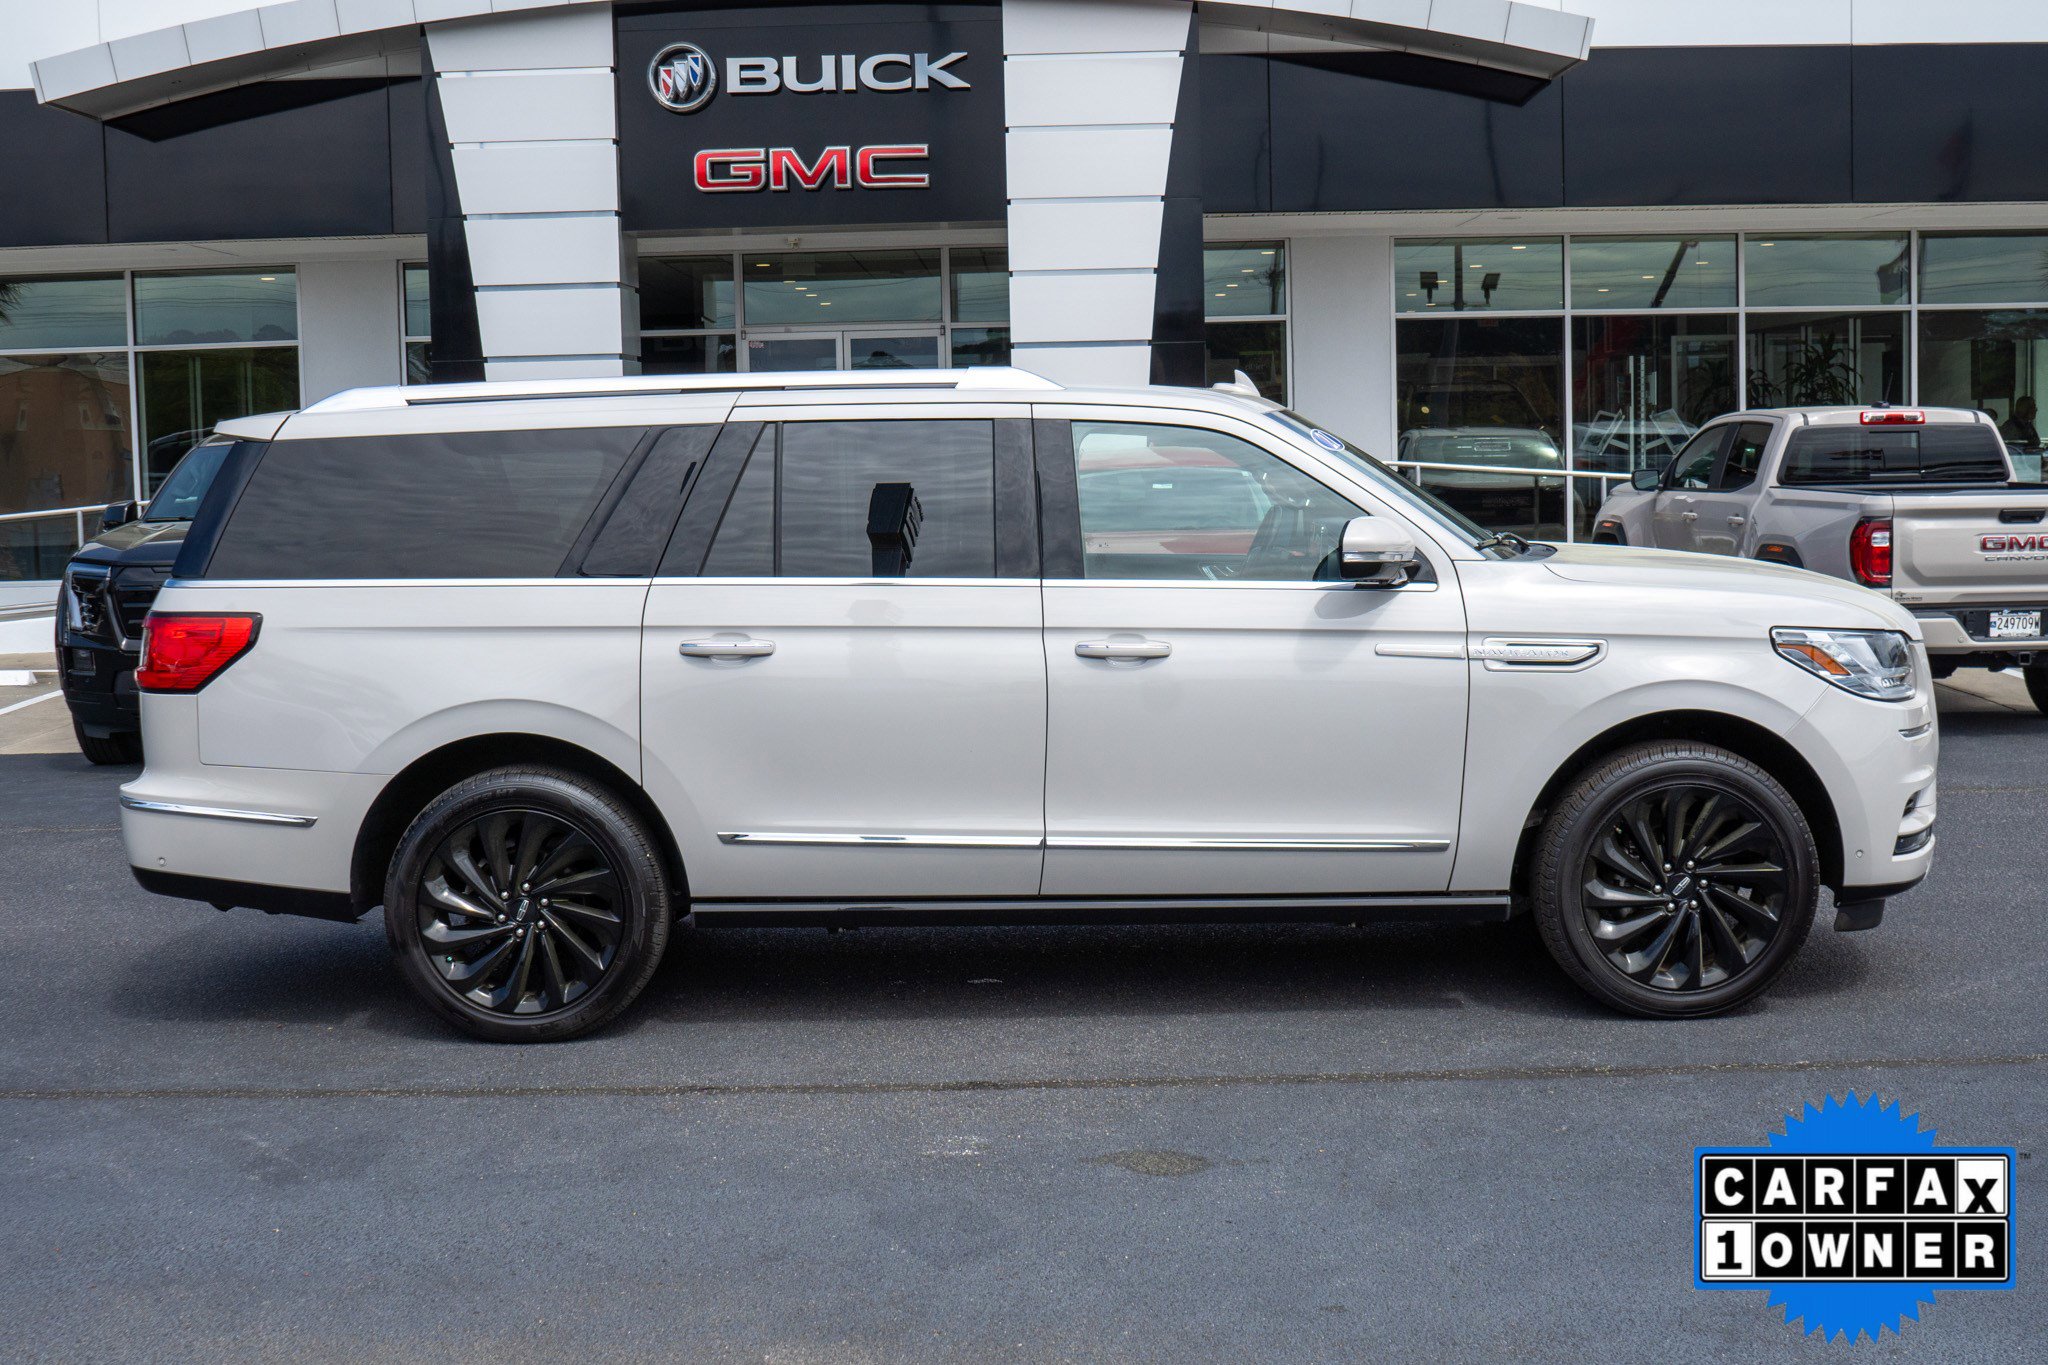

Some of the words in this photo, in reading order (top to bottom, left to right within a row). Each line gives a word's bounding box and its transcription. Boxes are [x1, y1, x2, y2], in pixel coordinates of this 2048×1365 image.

[726, 51, 971, 94] BUICK
[693, 144, 930, 192] GMC
[1997, 617, 2041, 630] 249709W
